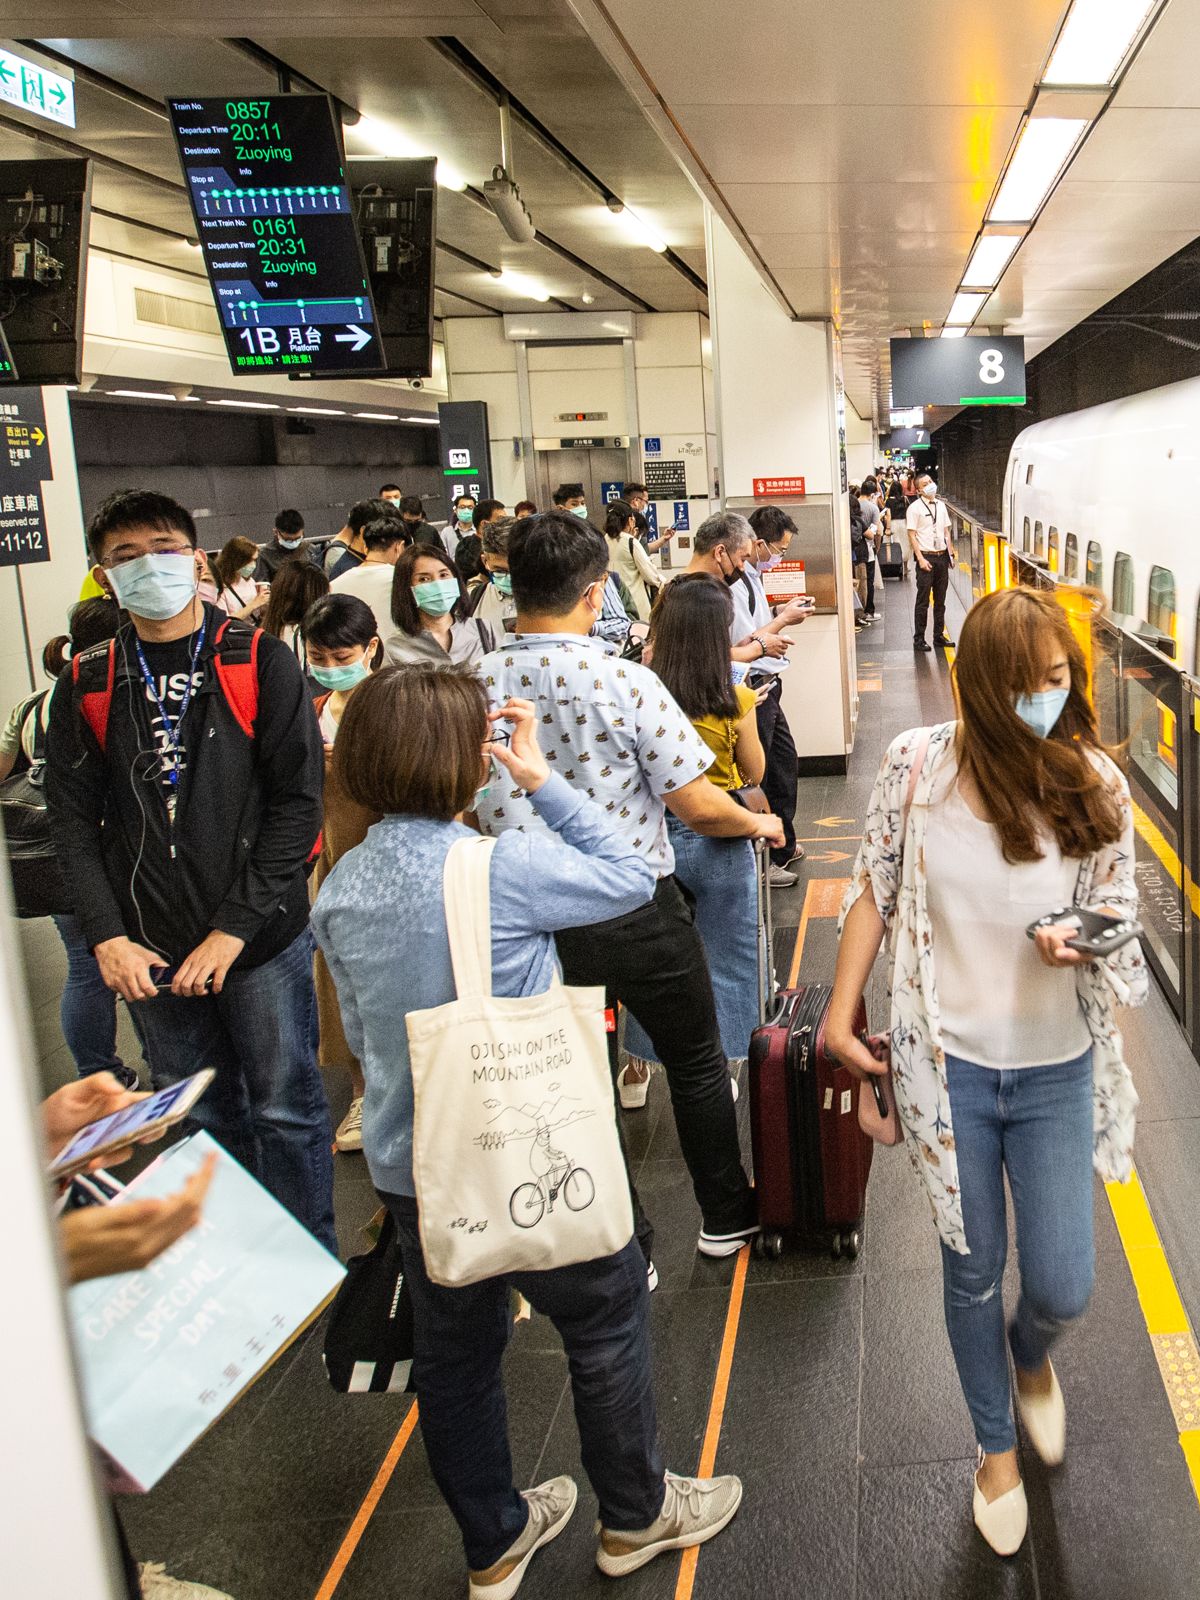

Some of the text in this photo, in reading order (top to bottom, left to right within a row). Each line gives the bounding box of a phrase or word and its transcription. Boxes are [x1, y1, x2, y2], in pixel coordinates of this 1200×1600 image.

[225, 101, 271, 120] 0857
[179, 127, 211, 135] Departure
[230, 122, 281, 141] 20:11
[184, 145, 293, 162] Destination Zuoying
[191, 176, 207, 184] Stop
[202, 220, 218, 228] Next
[252, 217, 297, 236] 0161
[257, 238, 306, 256] 20:31
[261, 260, 317, 276] Zuoying
[219, 288, 234, 296] Stop
[240, 327, 281, 354] 1B
[288, 326, 322, 345] 月台
[290, 344, 320, 352] Platform
[979, 348, 1005, 384] 8
[613, 437, 621, 448] 6
[916, 430, 925, 443] 7
[0, 494, 39, 512] 座車廂
[0, 516, 40, 528] eserved car
[471, 1028, 567, 1061] OJISAN ON THE
[472, 1048, 572, 1084] MOUNTAIN ROAD
[84, 1272, 152, 1341] CAKE
[133, 1258, 227, 1352] SPECIAL
[178, 1296, 226, 1346] DAY
